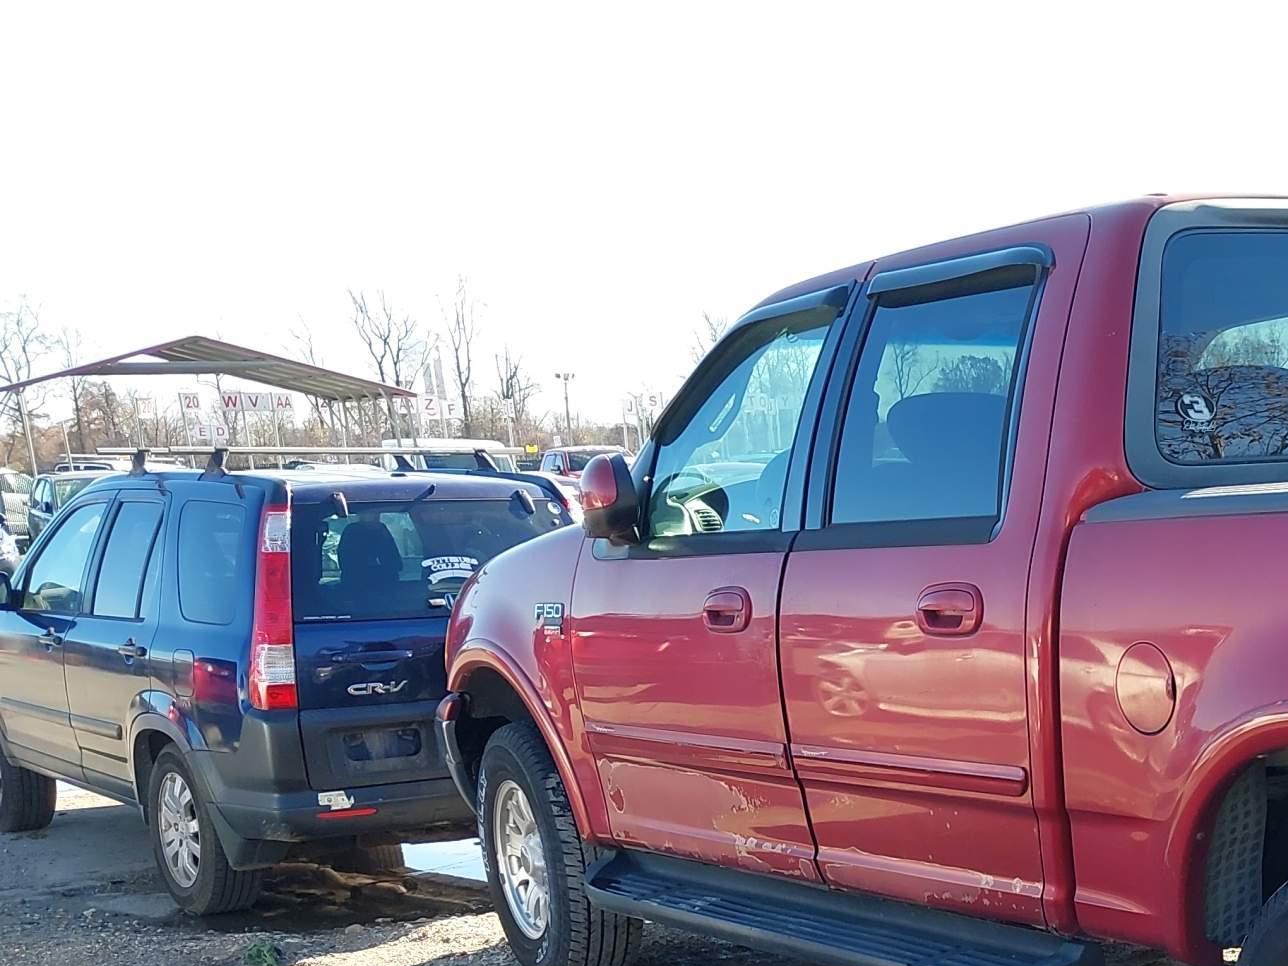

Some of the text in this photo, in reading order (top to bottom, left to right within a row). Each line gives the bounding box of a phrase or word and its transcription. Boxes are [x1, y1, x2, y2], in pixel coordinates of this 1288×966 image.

[184, 395, 199, 409] 20
[222, 395, 238, 409] W
[276, 396, 293, 409] AA
[424, 398, 435, 410] Z
[648, 395, 658, 407] S
[1182, 394, 1211, 420] 3
[447, 403, 456, 415] F
[216, 426, 225, 436] D
